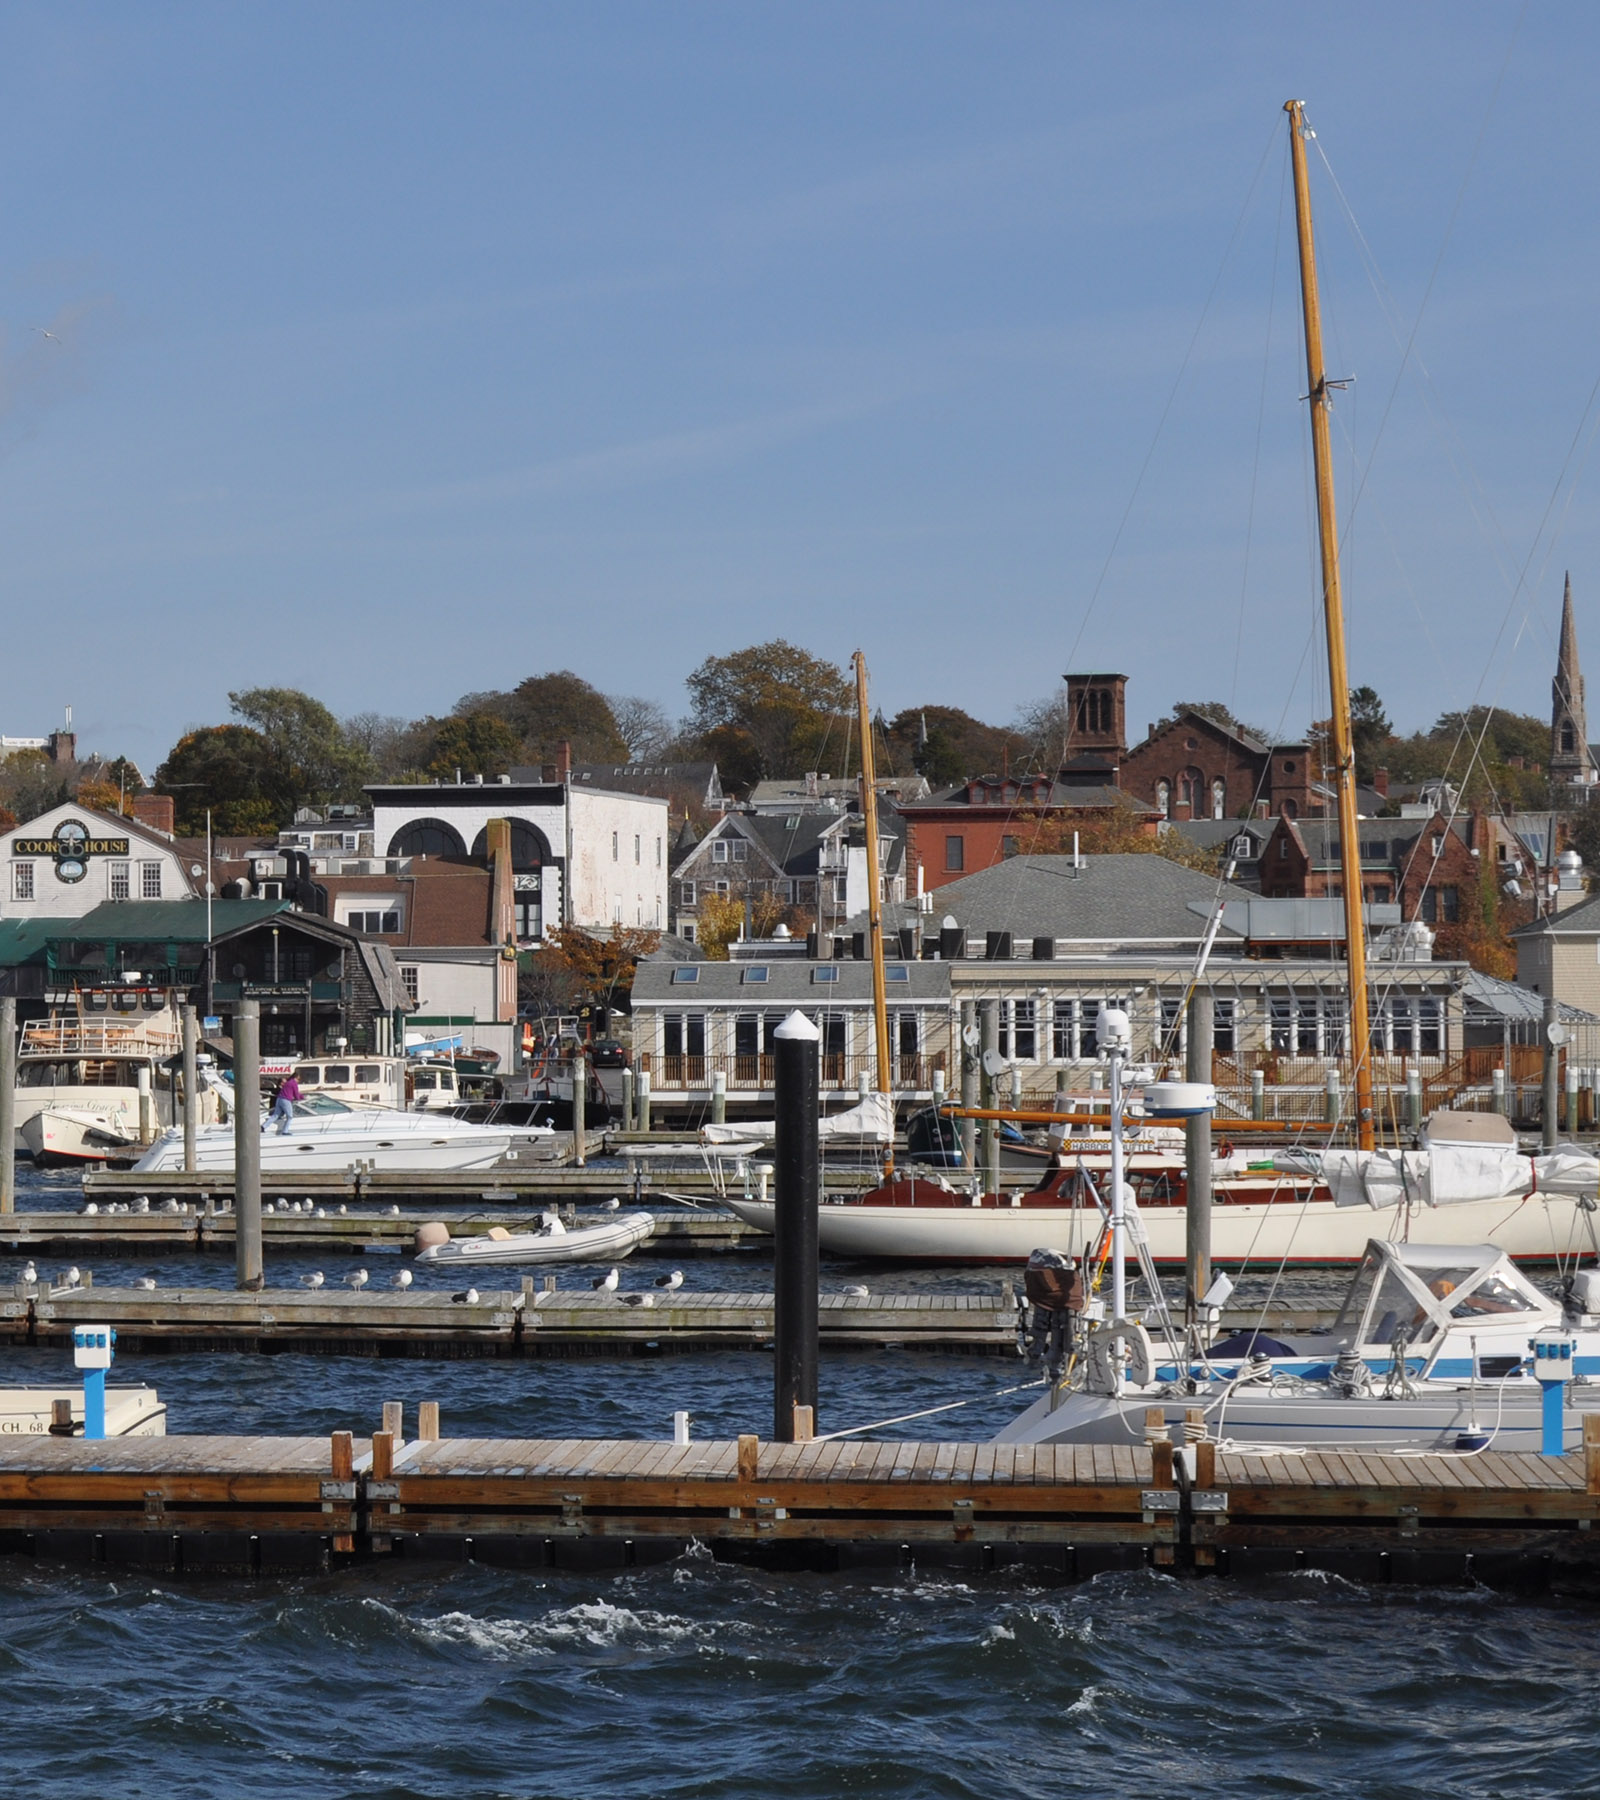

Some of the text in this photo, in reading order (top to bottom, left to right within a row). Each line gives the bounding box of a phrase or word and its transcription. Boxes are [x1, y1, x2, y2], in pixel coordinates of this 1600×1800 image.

[84, 841, 127, 852] HOUSE
[1122, 1143, 1153, 1151] HUTTLE
[2, 1422, 23, 1433] CH.
[29, 1422, 43, 1432] 68
